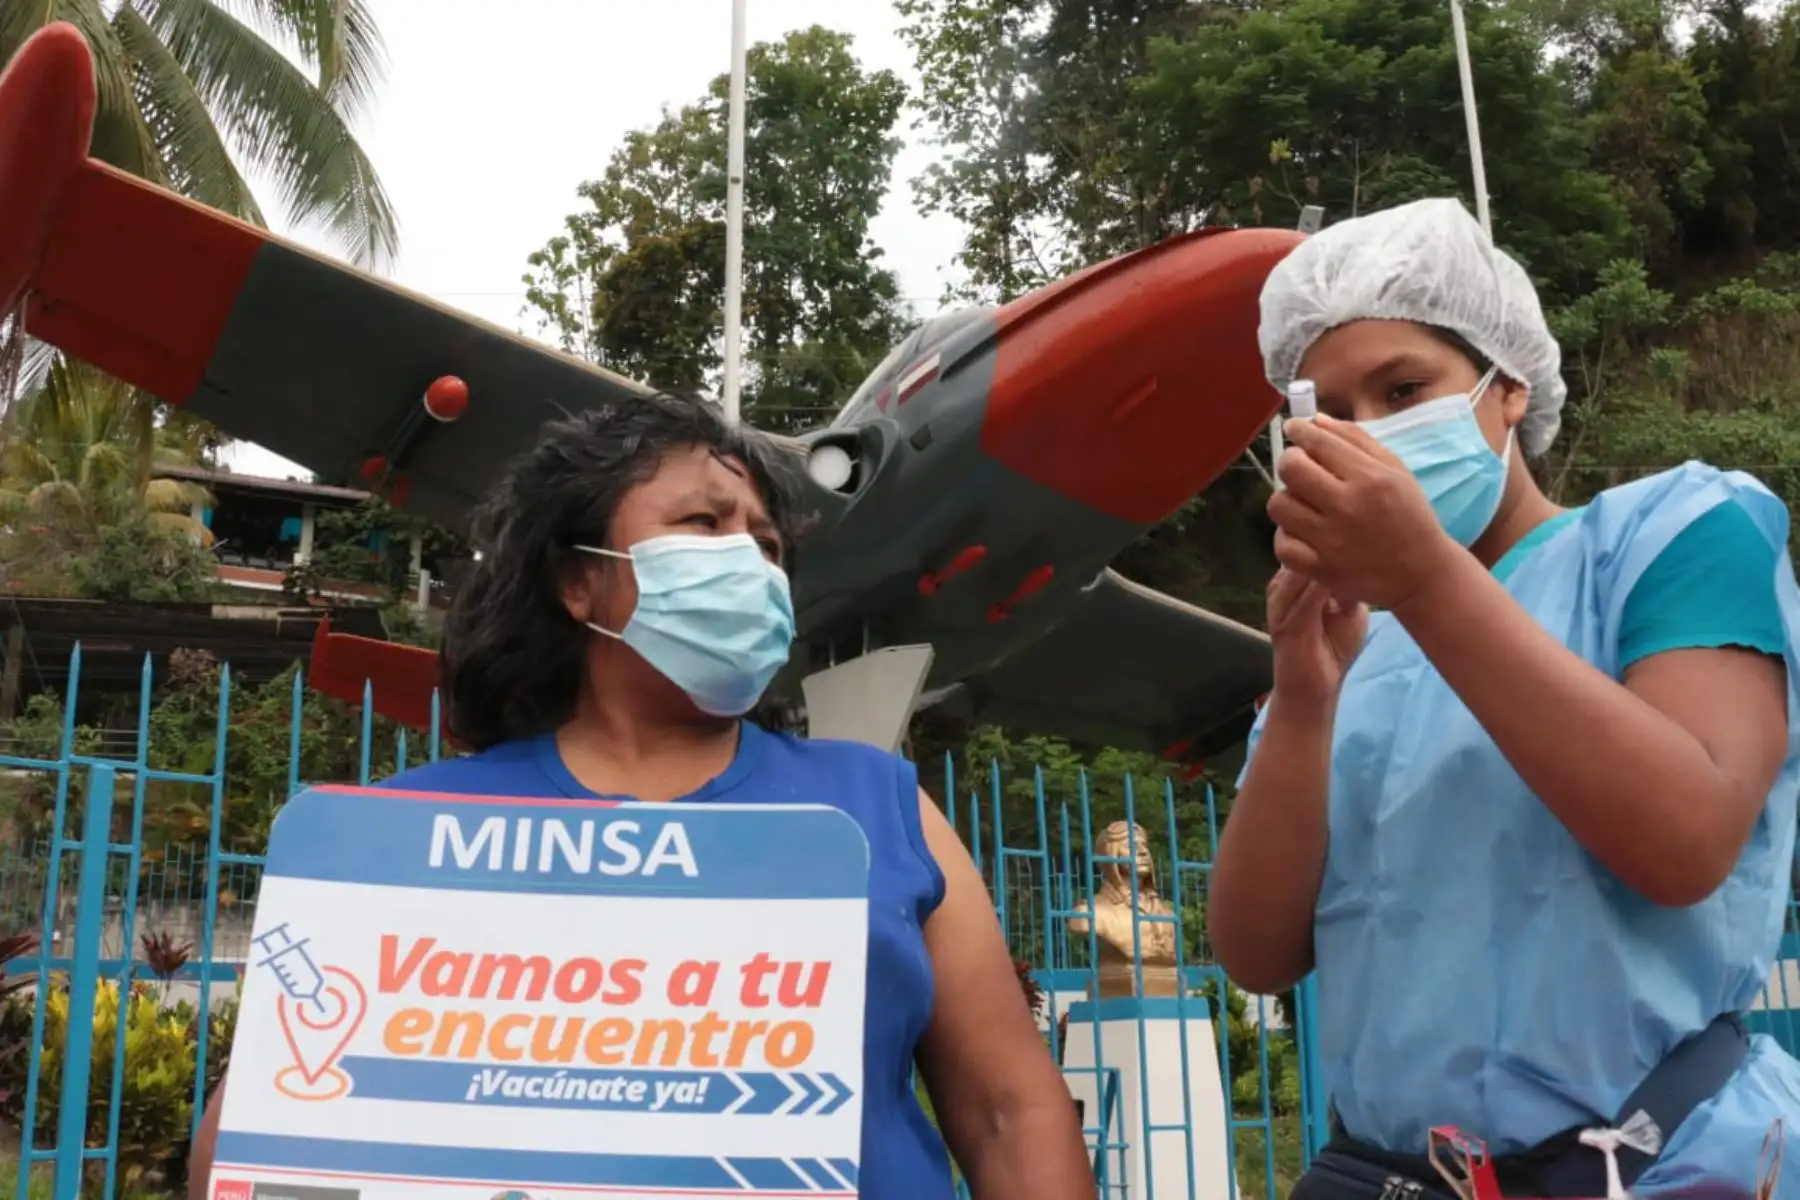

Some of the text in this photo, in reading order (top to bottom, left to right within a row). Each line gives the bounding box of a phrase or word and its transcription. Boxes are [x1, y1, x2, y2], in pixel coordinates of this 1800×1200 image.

[429, 814, 699, 877] MINSA
[377, 933, 831, 1008] Vamos a tu
[382, 1007, 815, 1069] encuentro
[465, 1069, 709, 1112] ¡Vacúnate ya!
